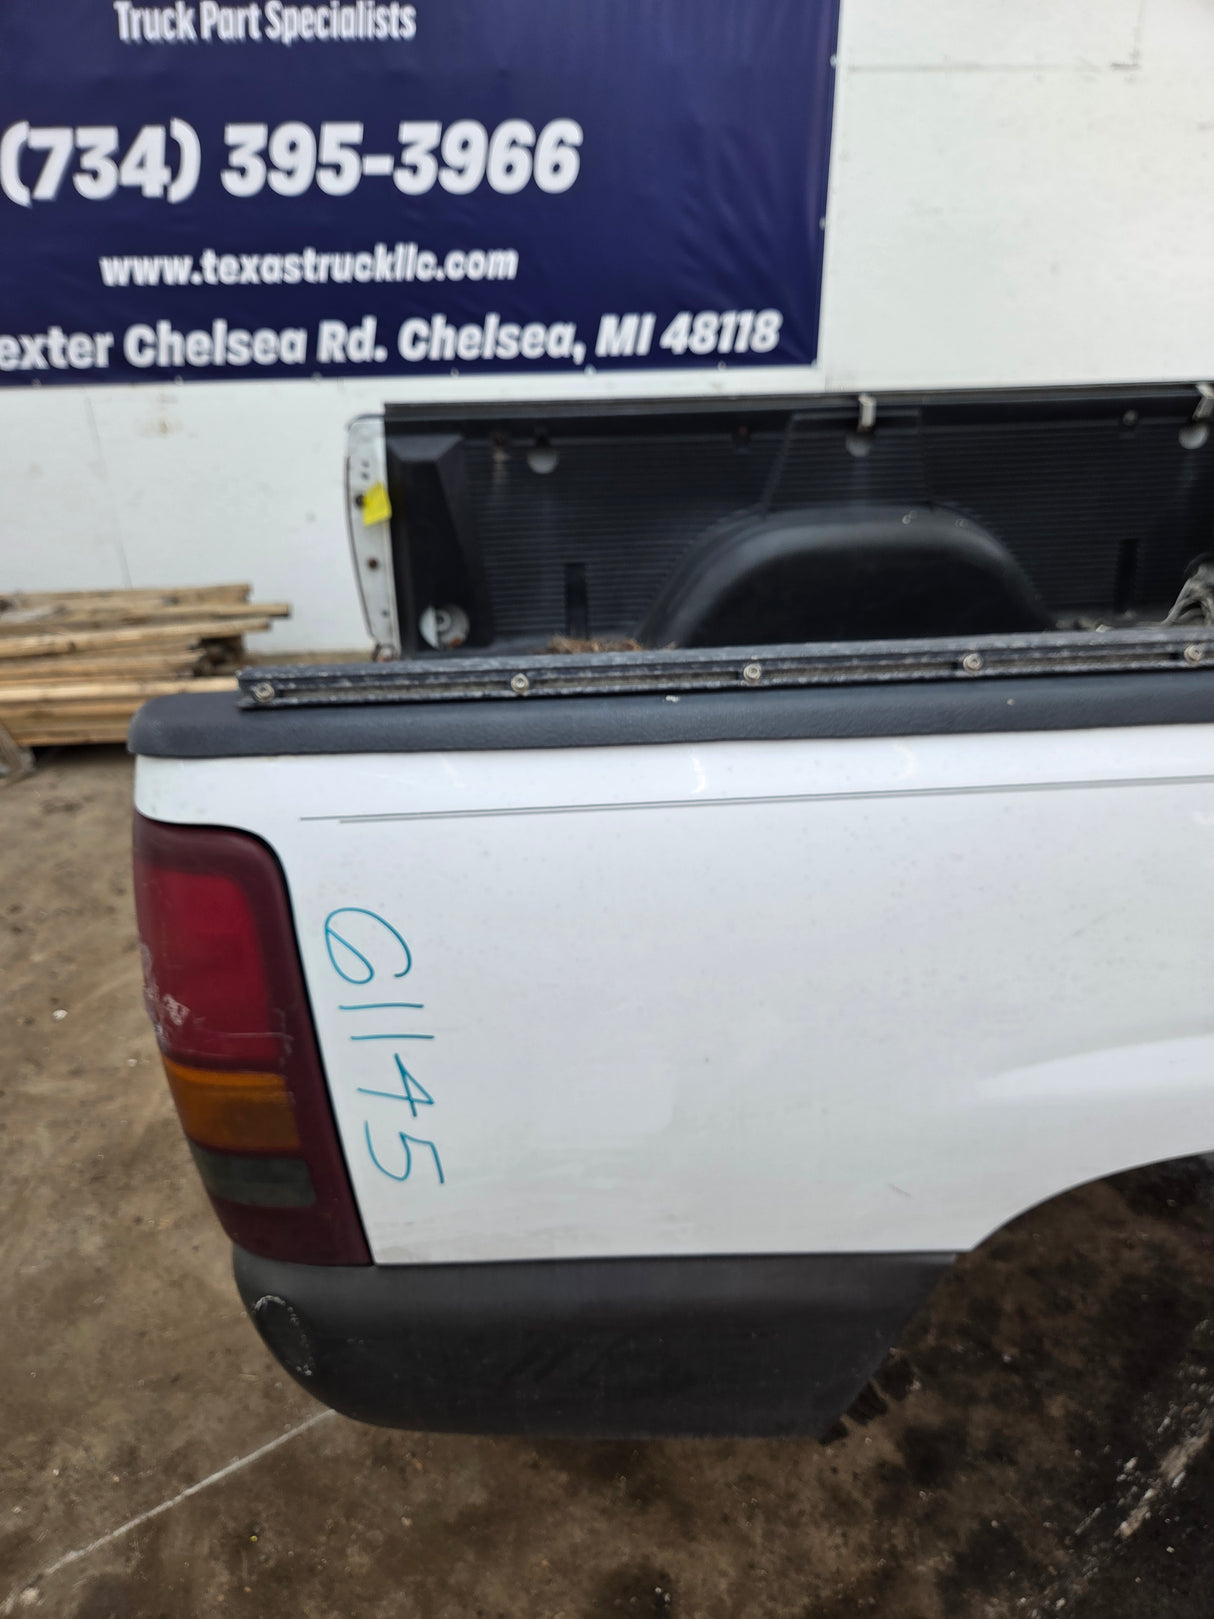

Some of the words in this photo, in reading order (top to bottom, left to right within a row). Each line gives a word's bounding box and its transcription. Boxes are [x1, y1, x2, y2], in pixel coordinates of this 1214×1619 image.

[114, 1, 198, 42] Truck
[200, 0, 261, 41] Part
[264, 0, 417, 46] Specialists
[0, 118, 200, 206] (734)
[220, 119, 584, 197] 395-3966
[100, 242, 518, 287] www.texastruckllc.com
[124, 319, 307, 368] Chelsea
[317, 316, 388, 363] Rd.
[398, 313, 586, 366] Chelsea,
[596, 313, 656, 357] MI
[660, 310, 782, 354] 48118
[324, 907, 445, 1185] 61145
